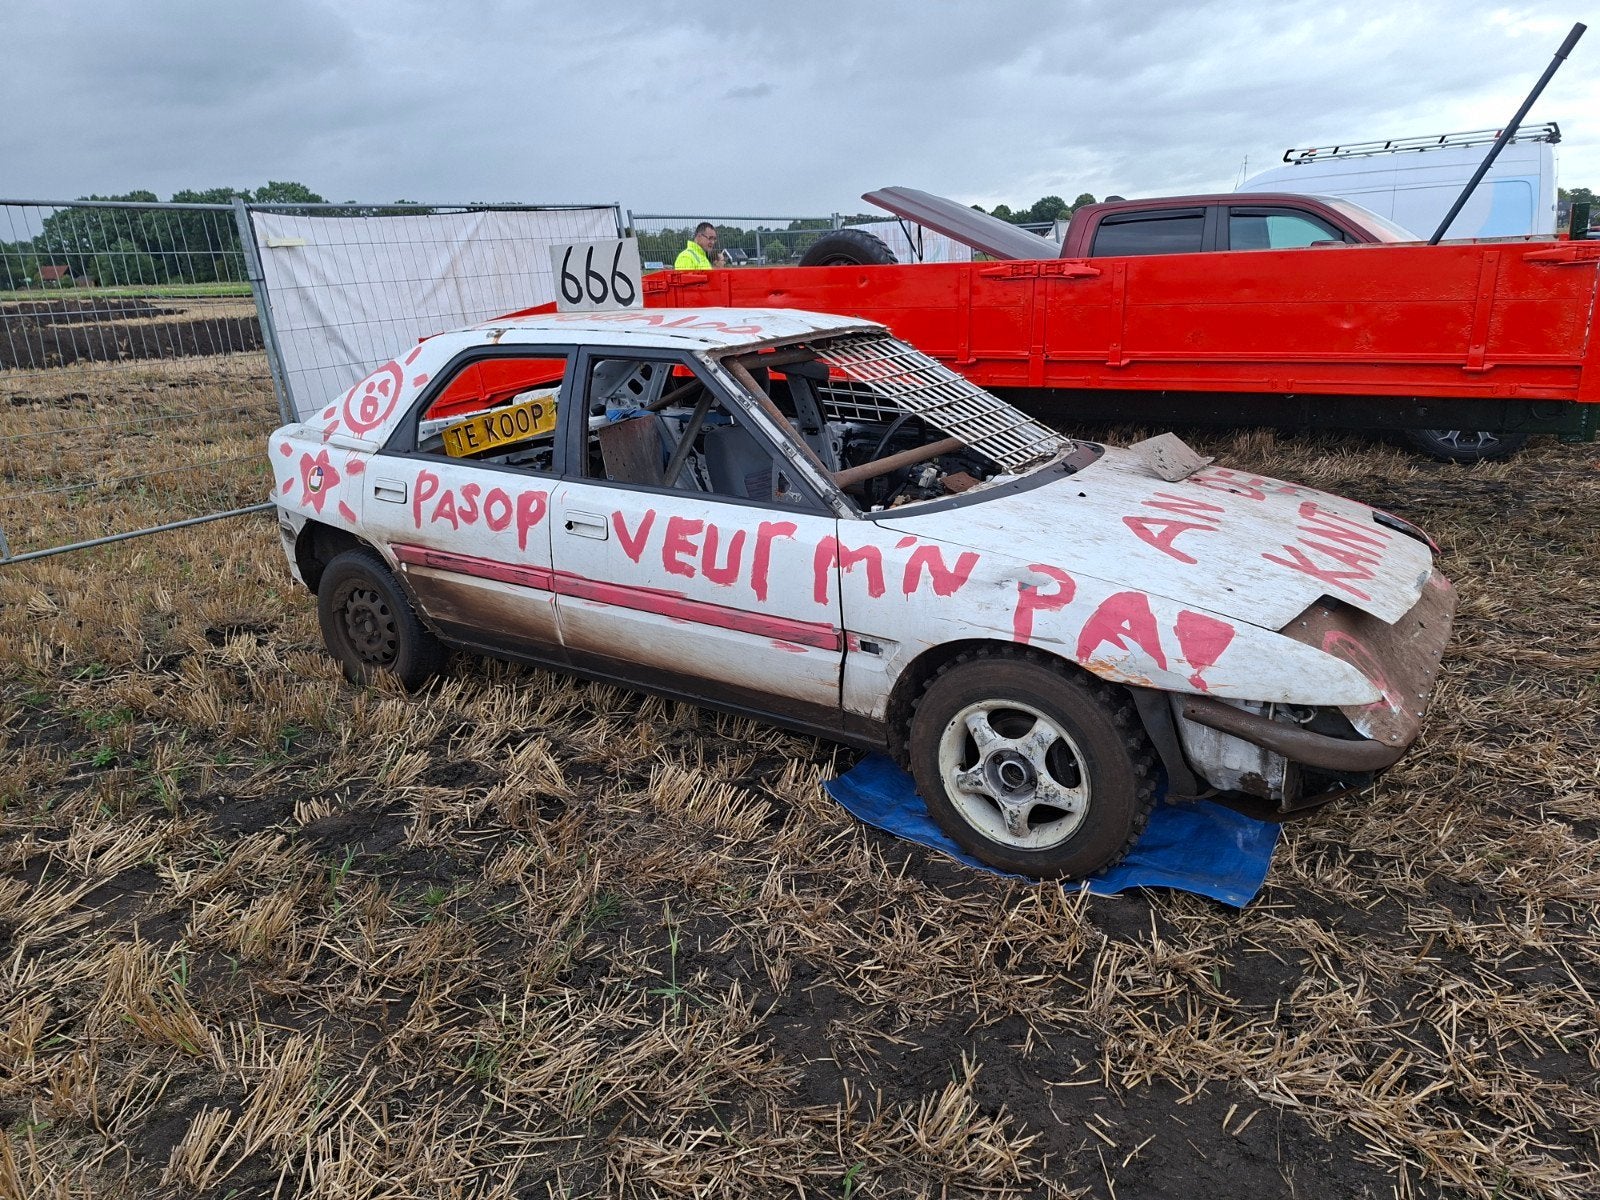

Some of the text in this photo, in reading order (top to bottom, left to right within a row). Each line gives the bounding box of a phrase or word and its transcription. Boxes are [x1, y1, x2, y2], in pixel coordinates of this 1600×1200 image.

[561, 241, 636, 307] 666
[451, 403, 543, 452] TE KOOP
[412, 469, 548, 551] PASOP
[1122, 491, 1226, 565] AN
[1261, 500, 1393, 602] KANT
